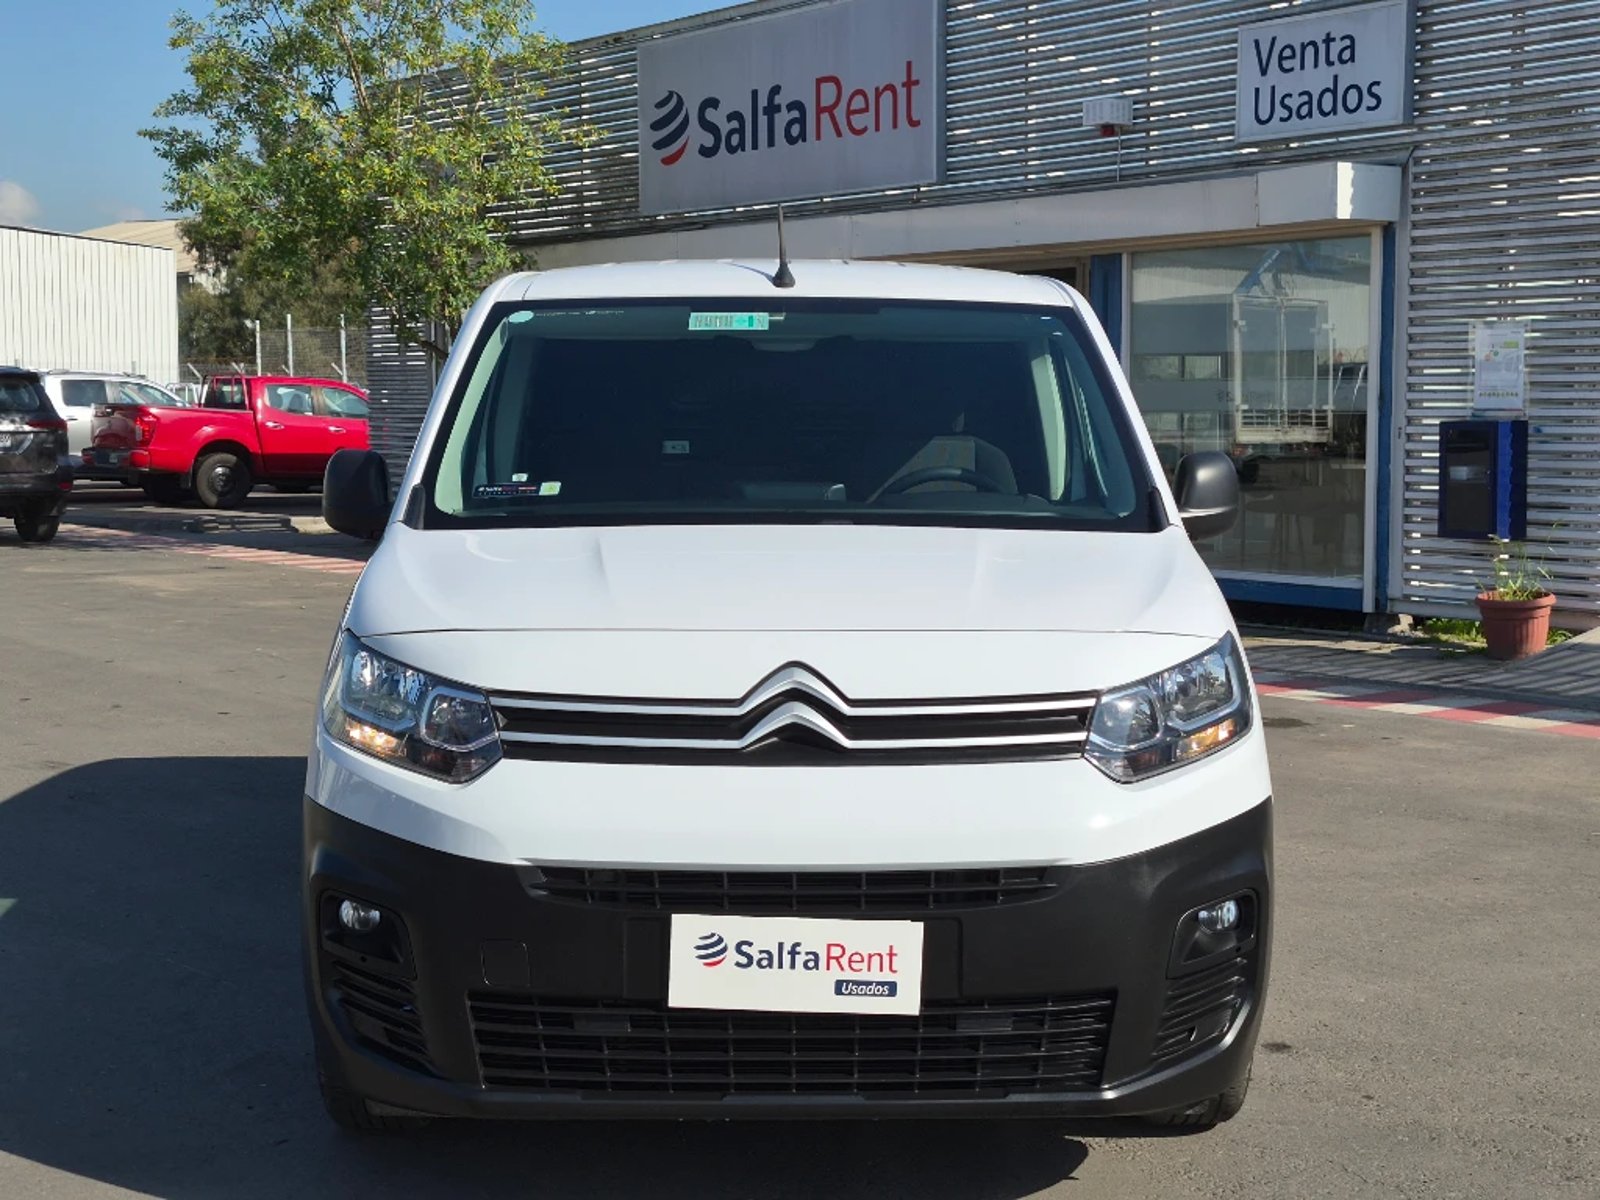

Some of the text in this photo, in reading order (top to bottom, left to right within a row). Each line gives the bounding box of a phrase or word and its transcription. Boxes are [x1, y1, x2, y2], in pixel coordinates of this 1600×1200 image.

[1253, 31, 1356, 77] Venta
[697, 60, 921, 159] SalfaRent
[1253, 74, 1383, 126] Usados
[733, 939, 898, 974] SalfaRent
[841, 982, 890, 996] Usados
